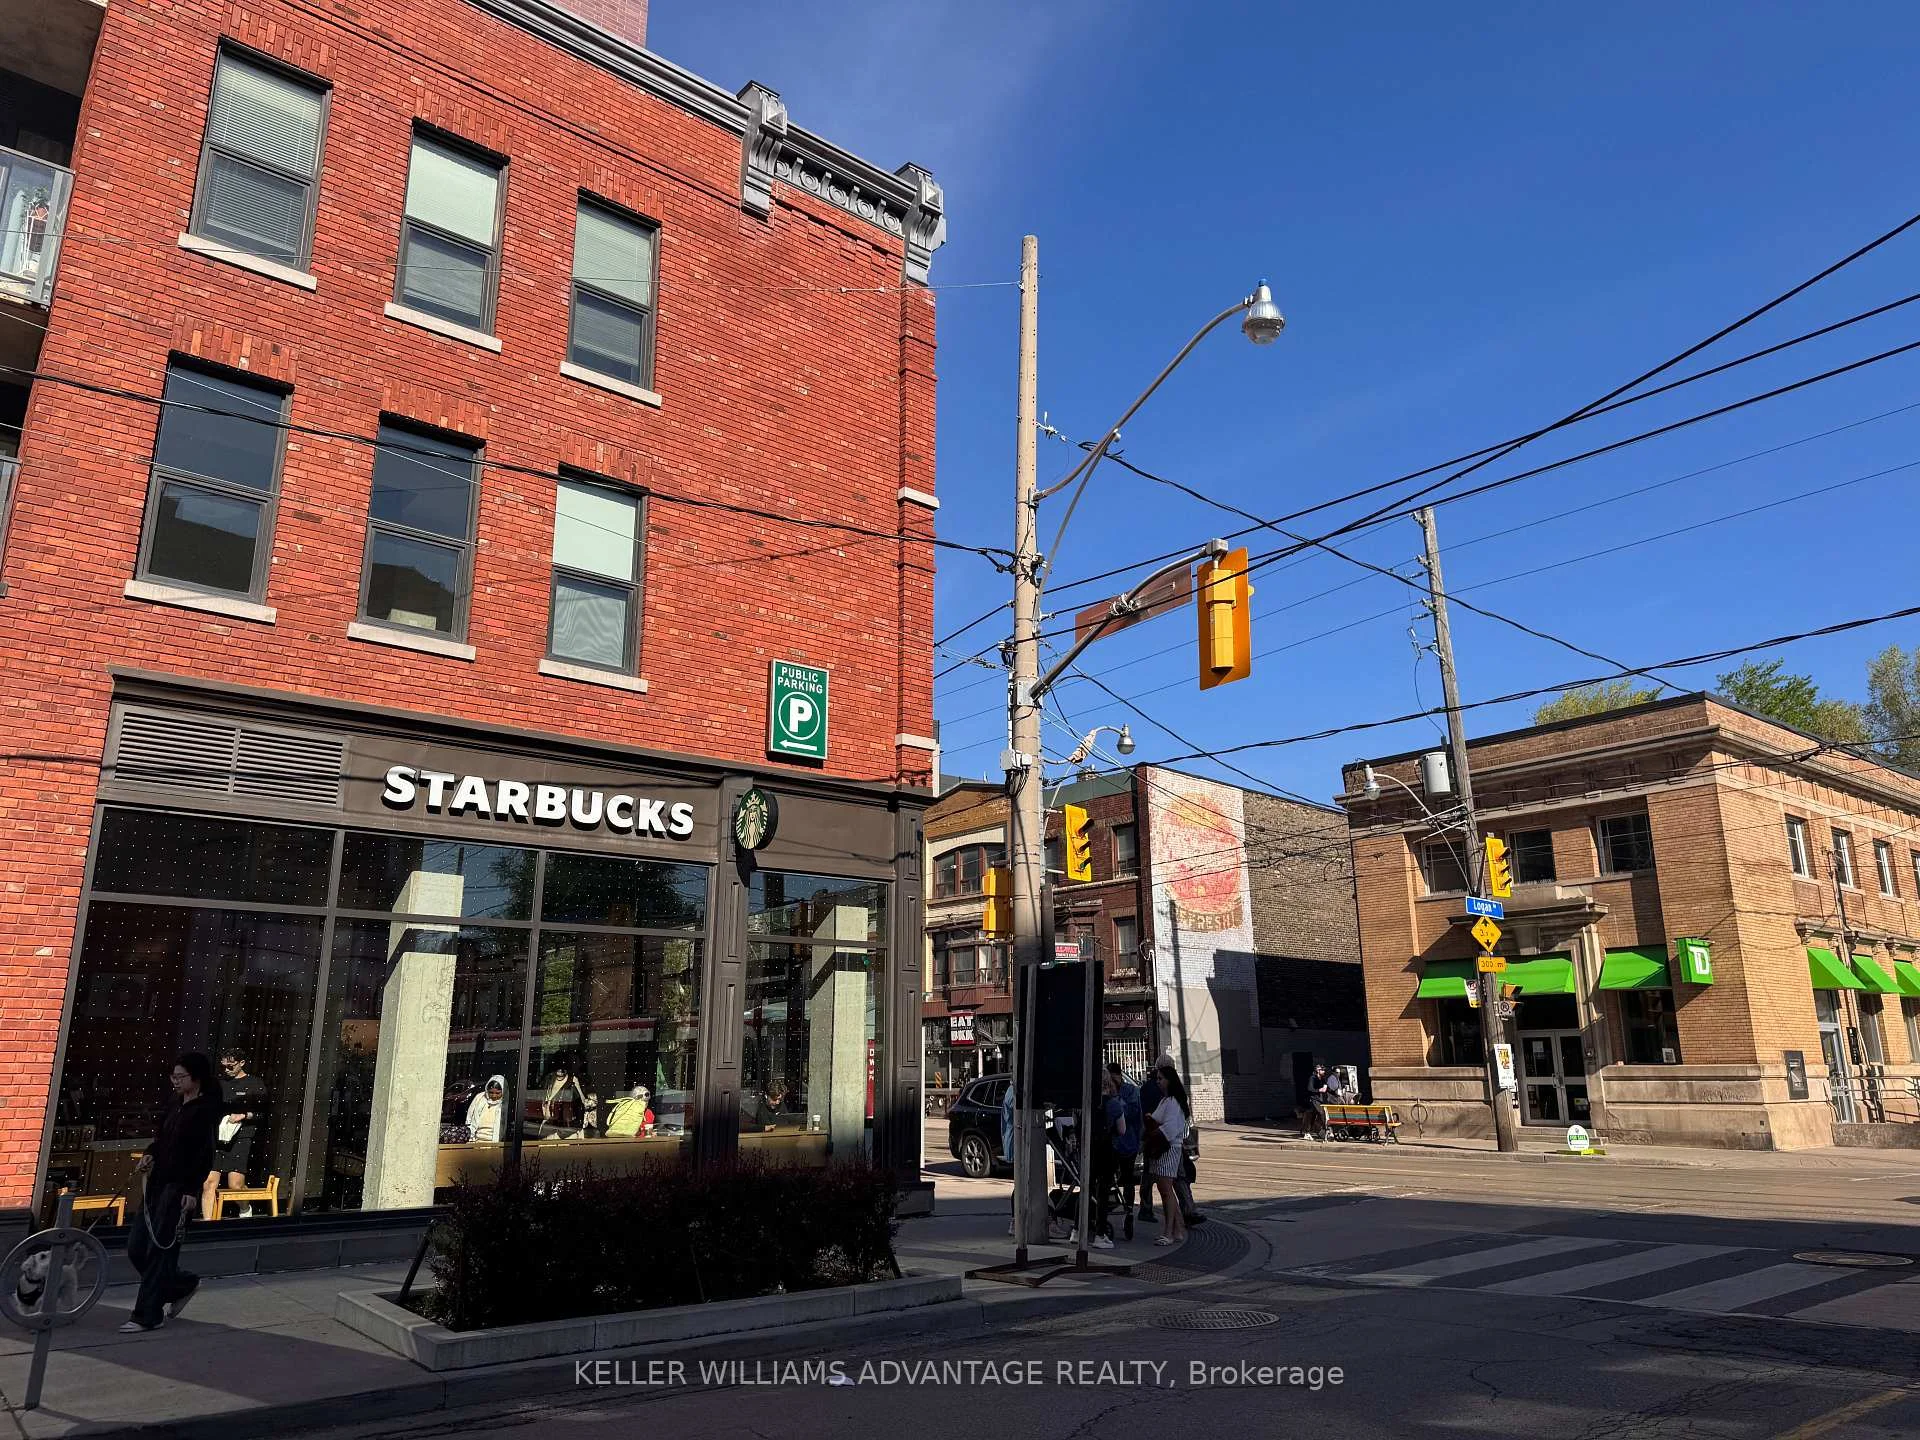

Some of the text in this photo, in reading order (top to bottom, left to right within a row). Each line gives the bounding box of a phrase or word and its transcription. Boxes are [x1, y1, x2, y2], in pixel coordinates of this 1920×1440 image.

[782, 666, 818, 682] PUBLIC
[777, 676, 823, 694] PARKING
[789, 698, 812, 733] P
[383, 765, 694, 838] STARBUCKS
[1473, 899, 1492, 914] Logan
[1689, 945, 1710, 975] TD
[950, 1015, 973, 1028] EAT
